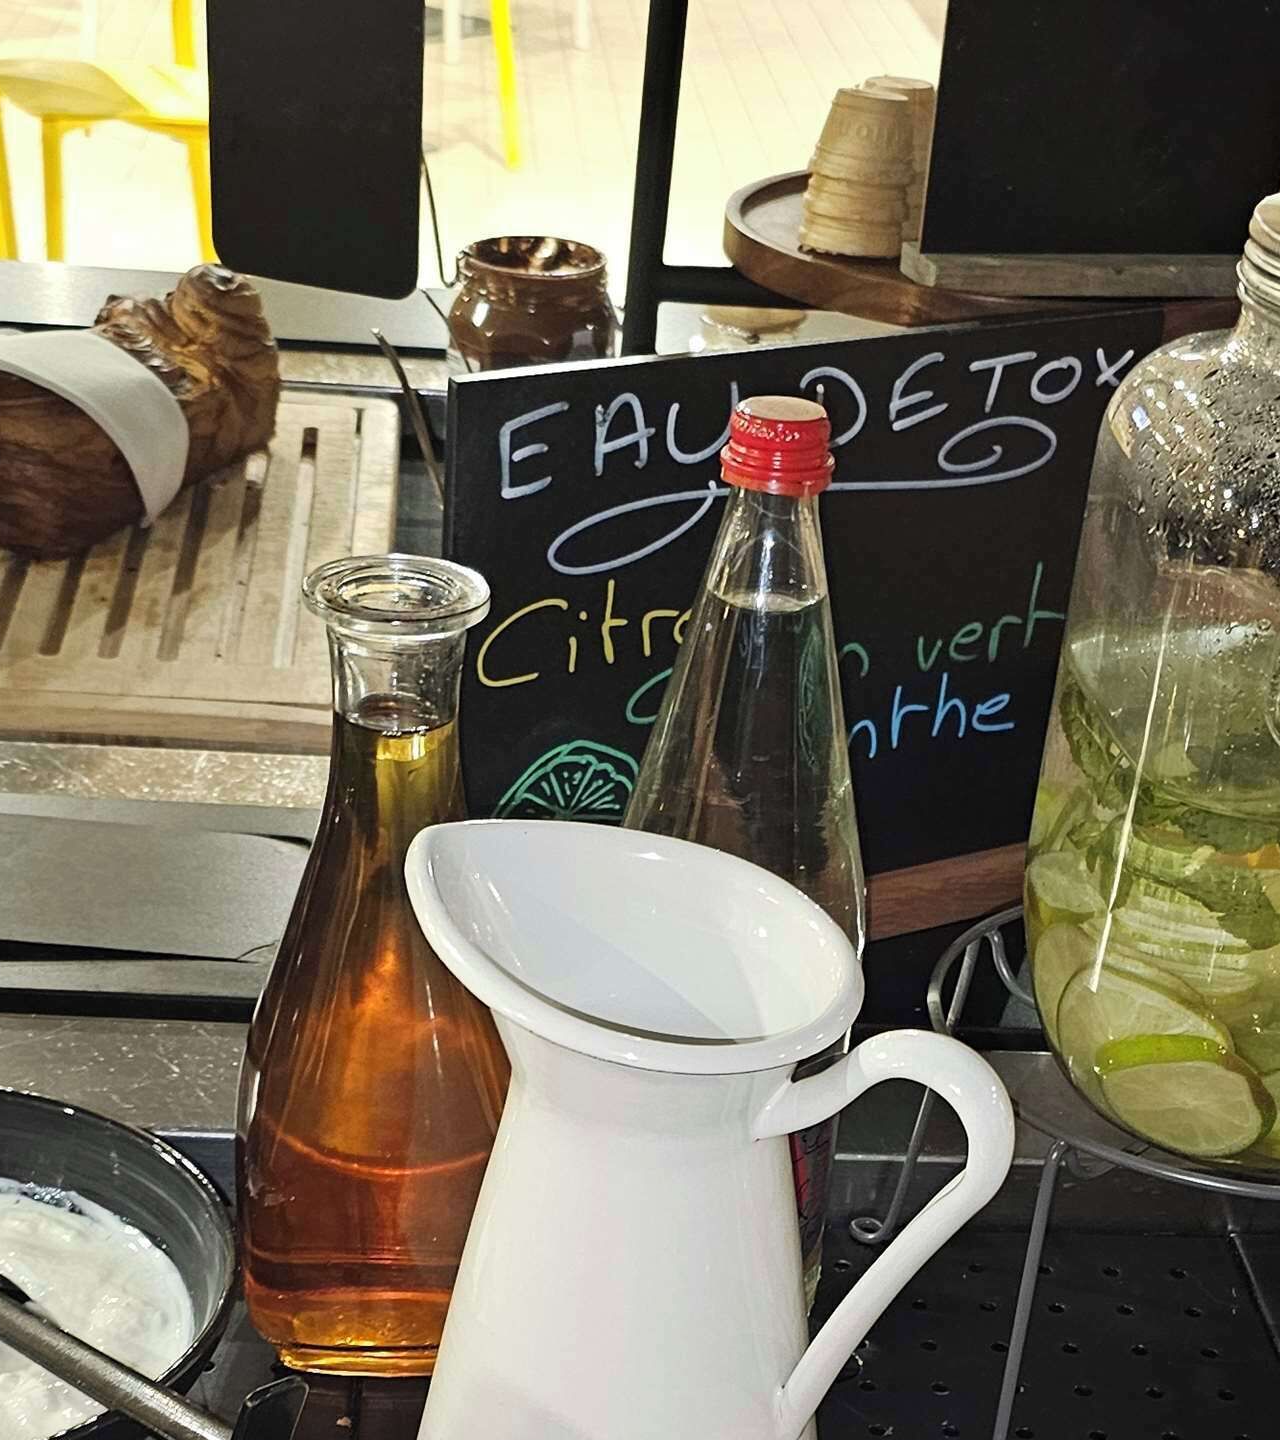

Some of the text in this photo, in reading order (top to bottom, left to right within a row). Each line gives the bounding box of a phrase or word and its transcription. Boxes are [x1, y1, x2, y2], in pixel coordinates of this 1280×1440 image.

[499, 348, 1134, 500] EAU DETOX
[917, 561, 1066, 672] vert
